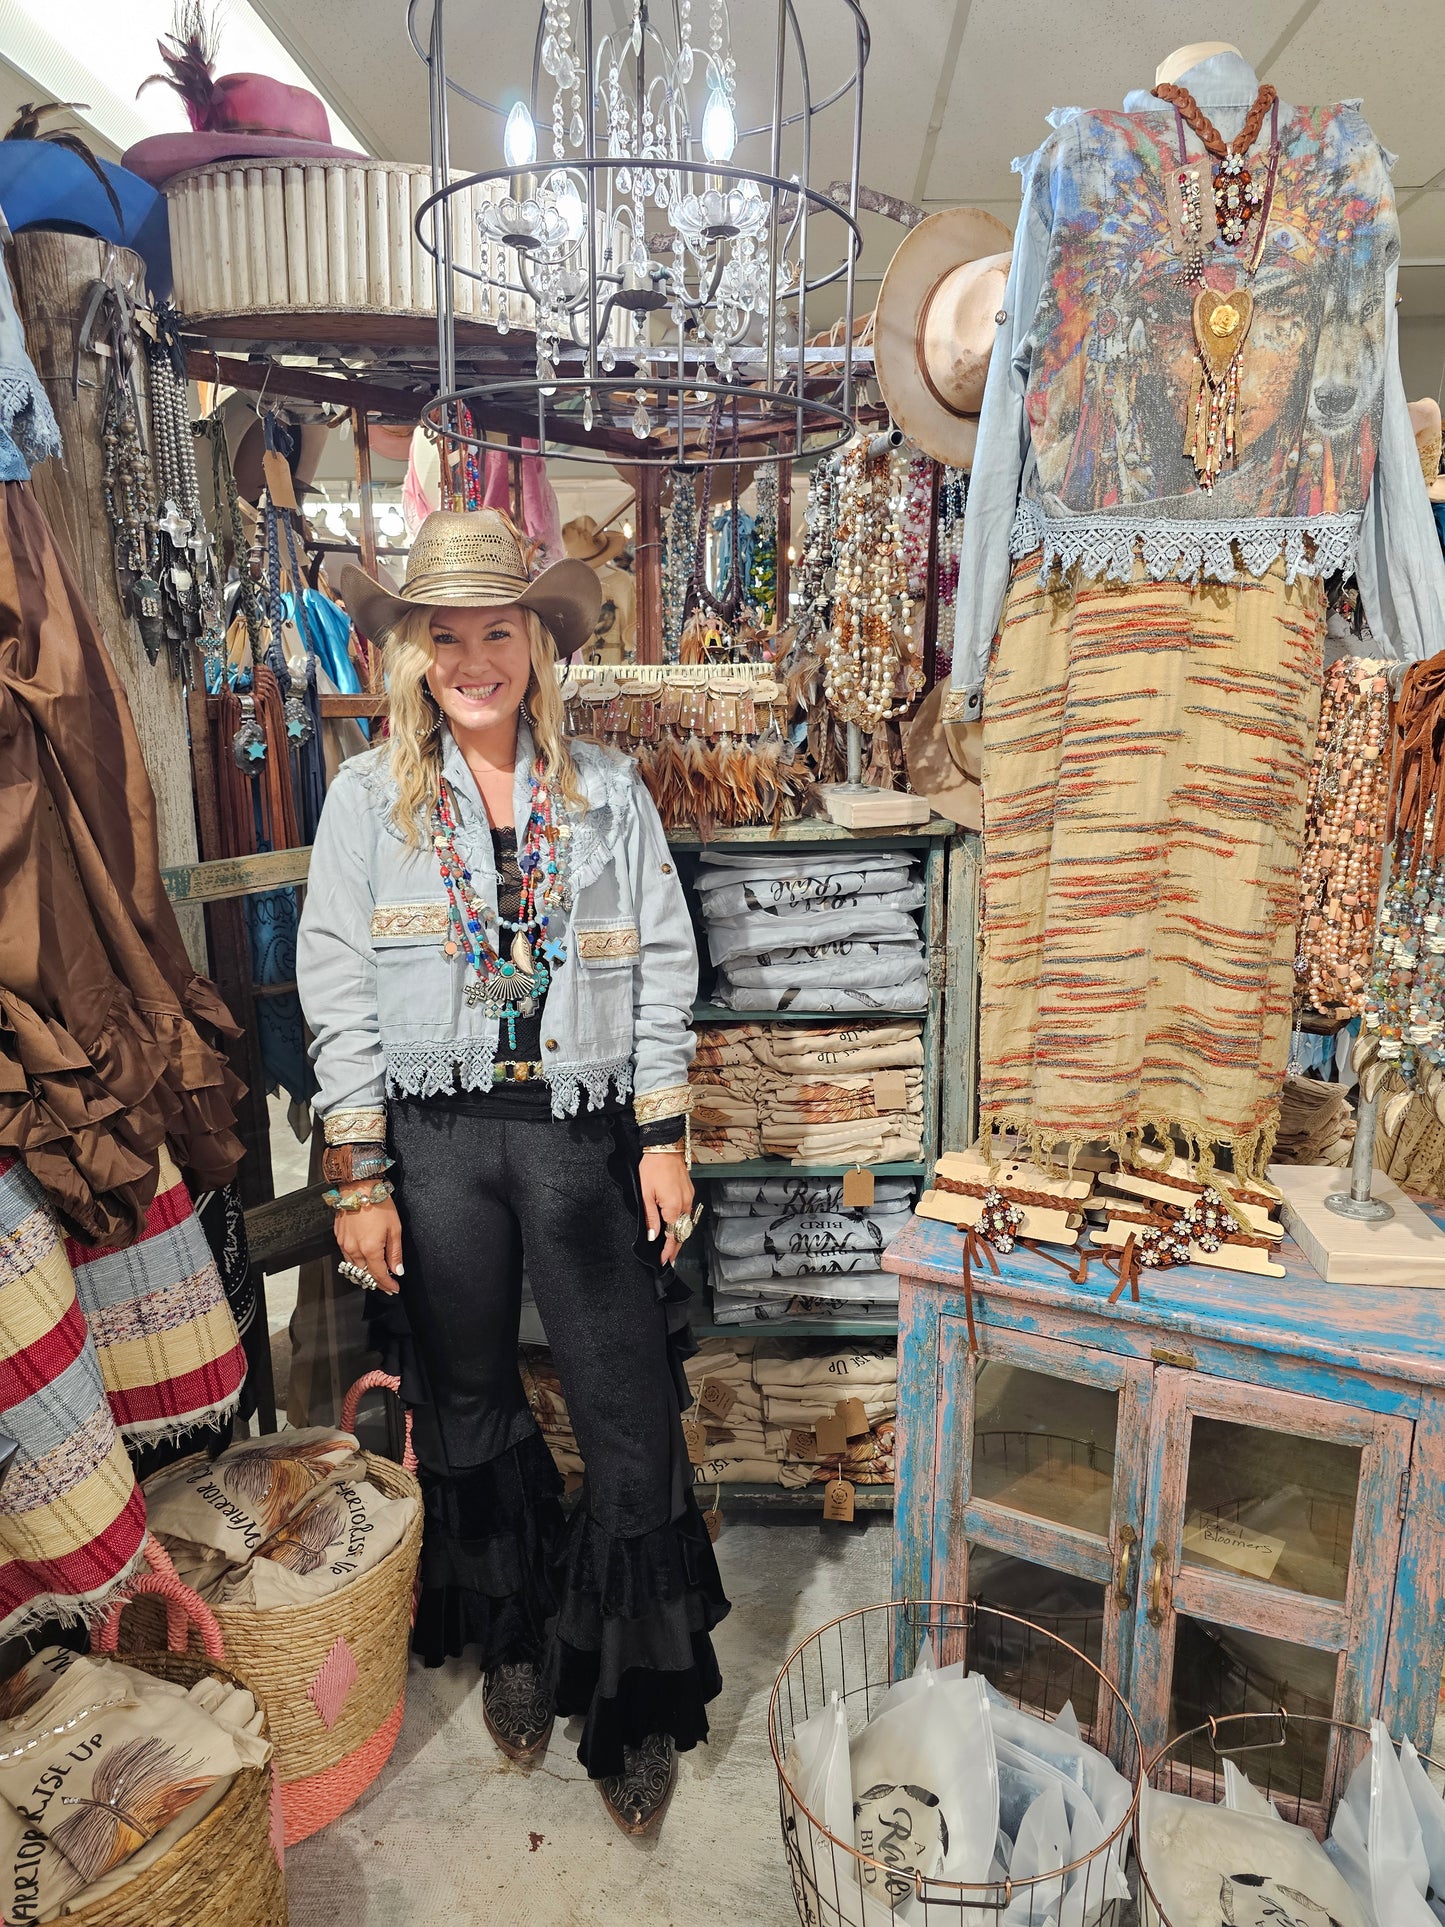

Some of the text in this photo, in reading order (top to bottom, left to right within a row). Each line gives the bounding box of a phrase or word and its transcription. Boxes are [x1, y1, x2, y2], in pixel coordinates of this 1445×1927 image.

[800, 1221, 843, 1229] BIRD
[196, 1482, 261, 1549] WARRIOR
[1204, 1530, 1272, 1553] Bloomers
[16, 1763, 72, 1824] RISE
[914, 1841, 926, 1857] A
